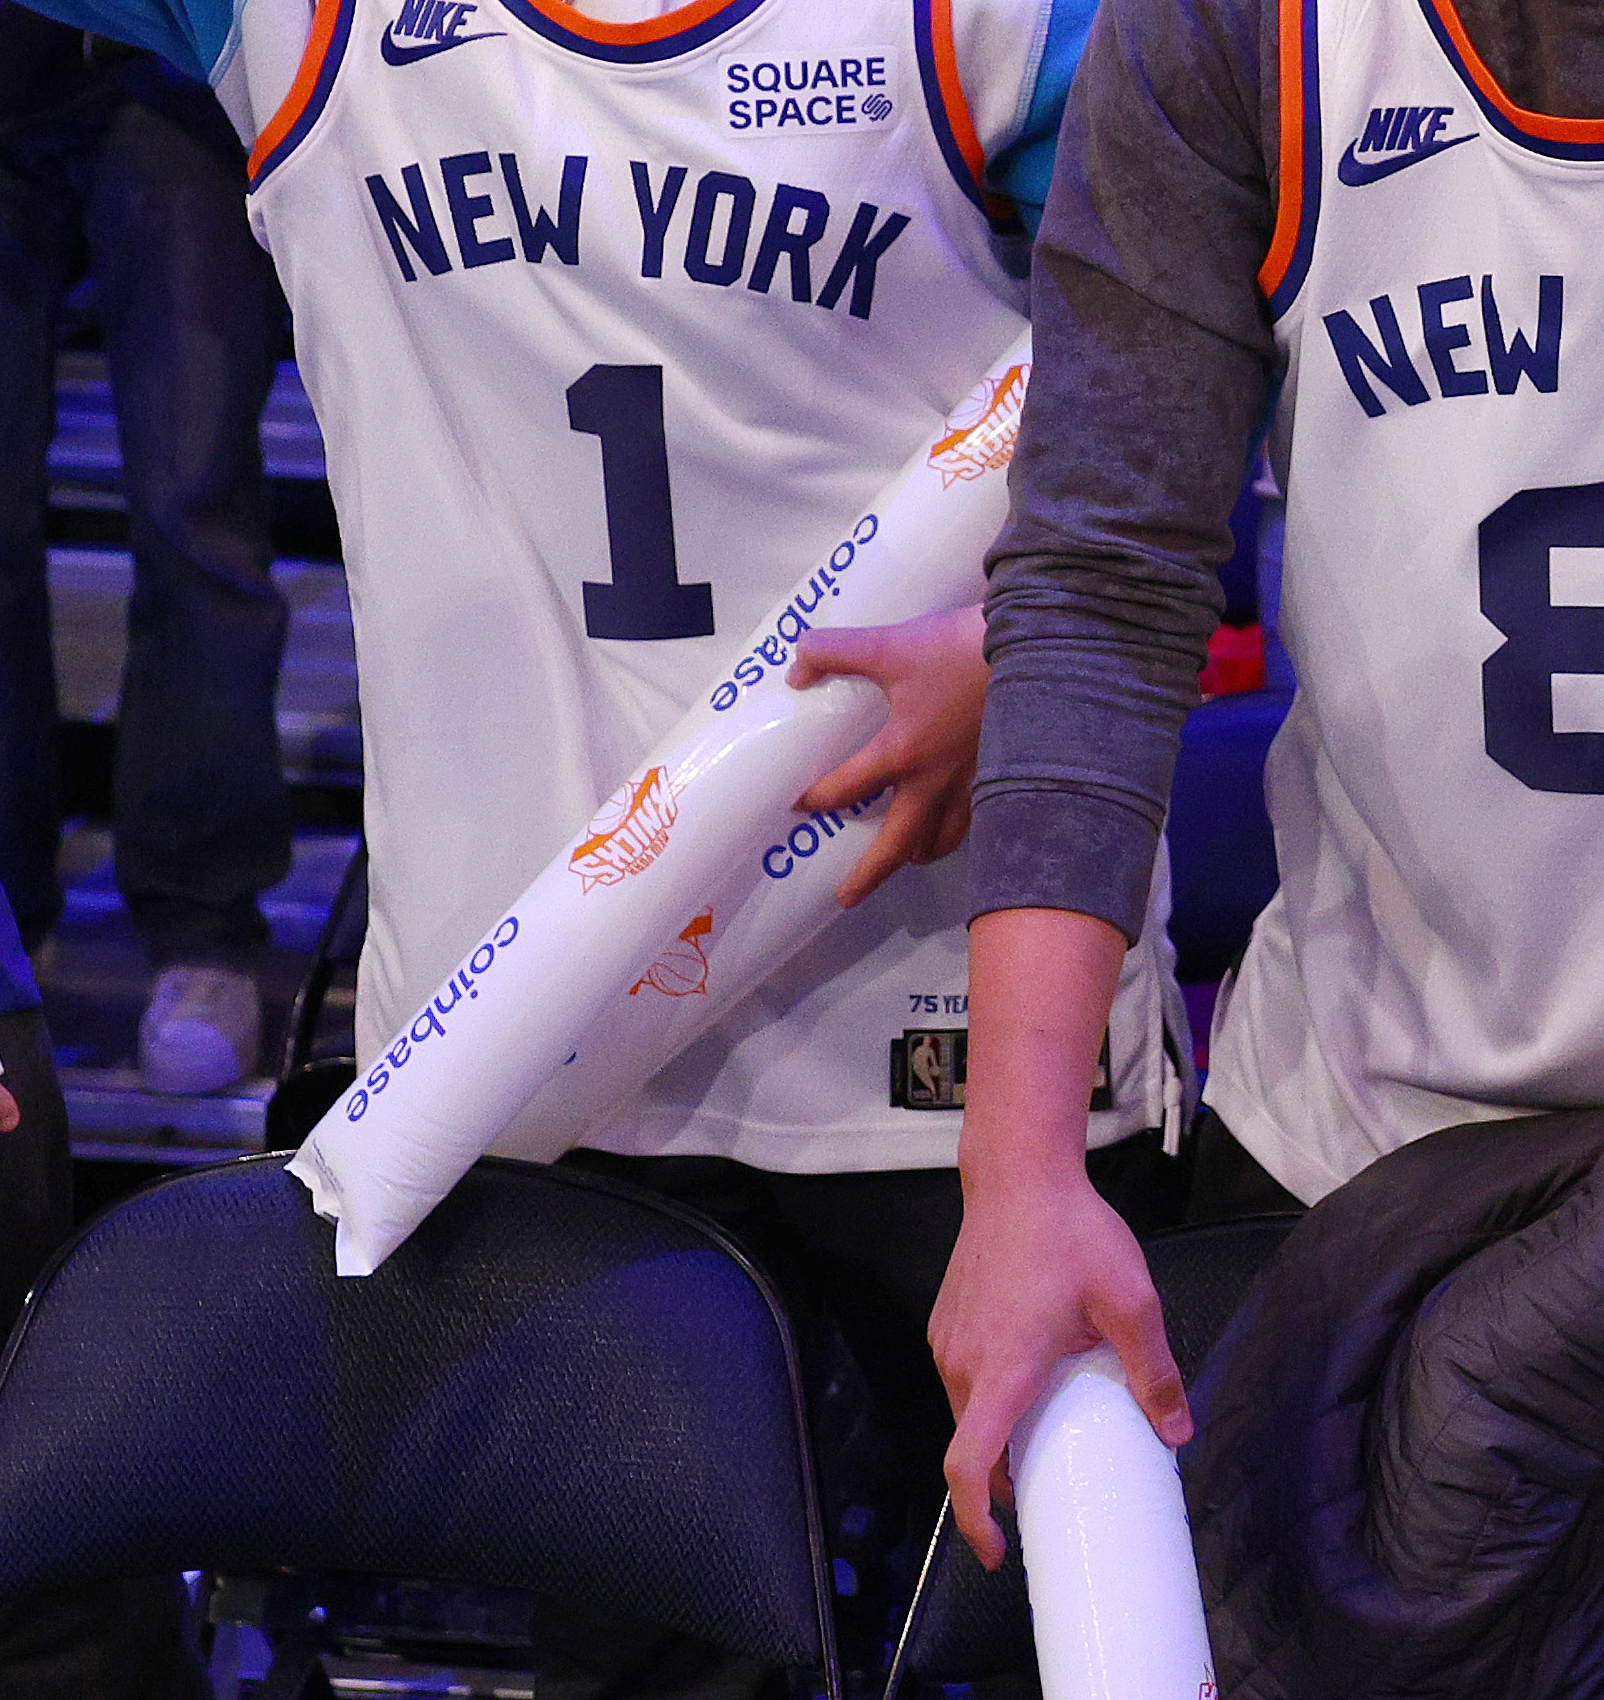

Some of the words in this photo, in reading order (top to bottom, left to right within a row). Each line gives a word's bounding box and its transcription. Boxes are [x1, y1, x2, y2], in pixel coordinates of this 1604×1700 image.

[727, 57, 887, 94] SQUARE
[729, 95, 858, 130] SPACE
[1358, 106, 1455, 153] NIKE
[365, 150, 589, 283] NEW
[629, 160, 912, 320] YORK
[1322, 274, 1564, 419] NEW
[566, 363, 715, 641] 1
[710, 513, 879, 712] coinbase
[346, 916, 519, 1122] coinbase
[909, 994, 938, 1014] 75
